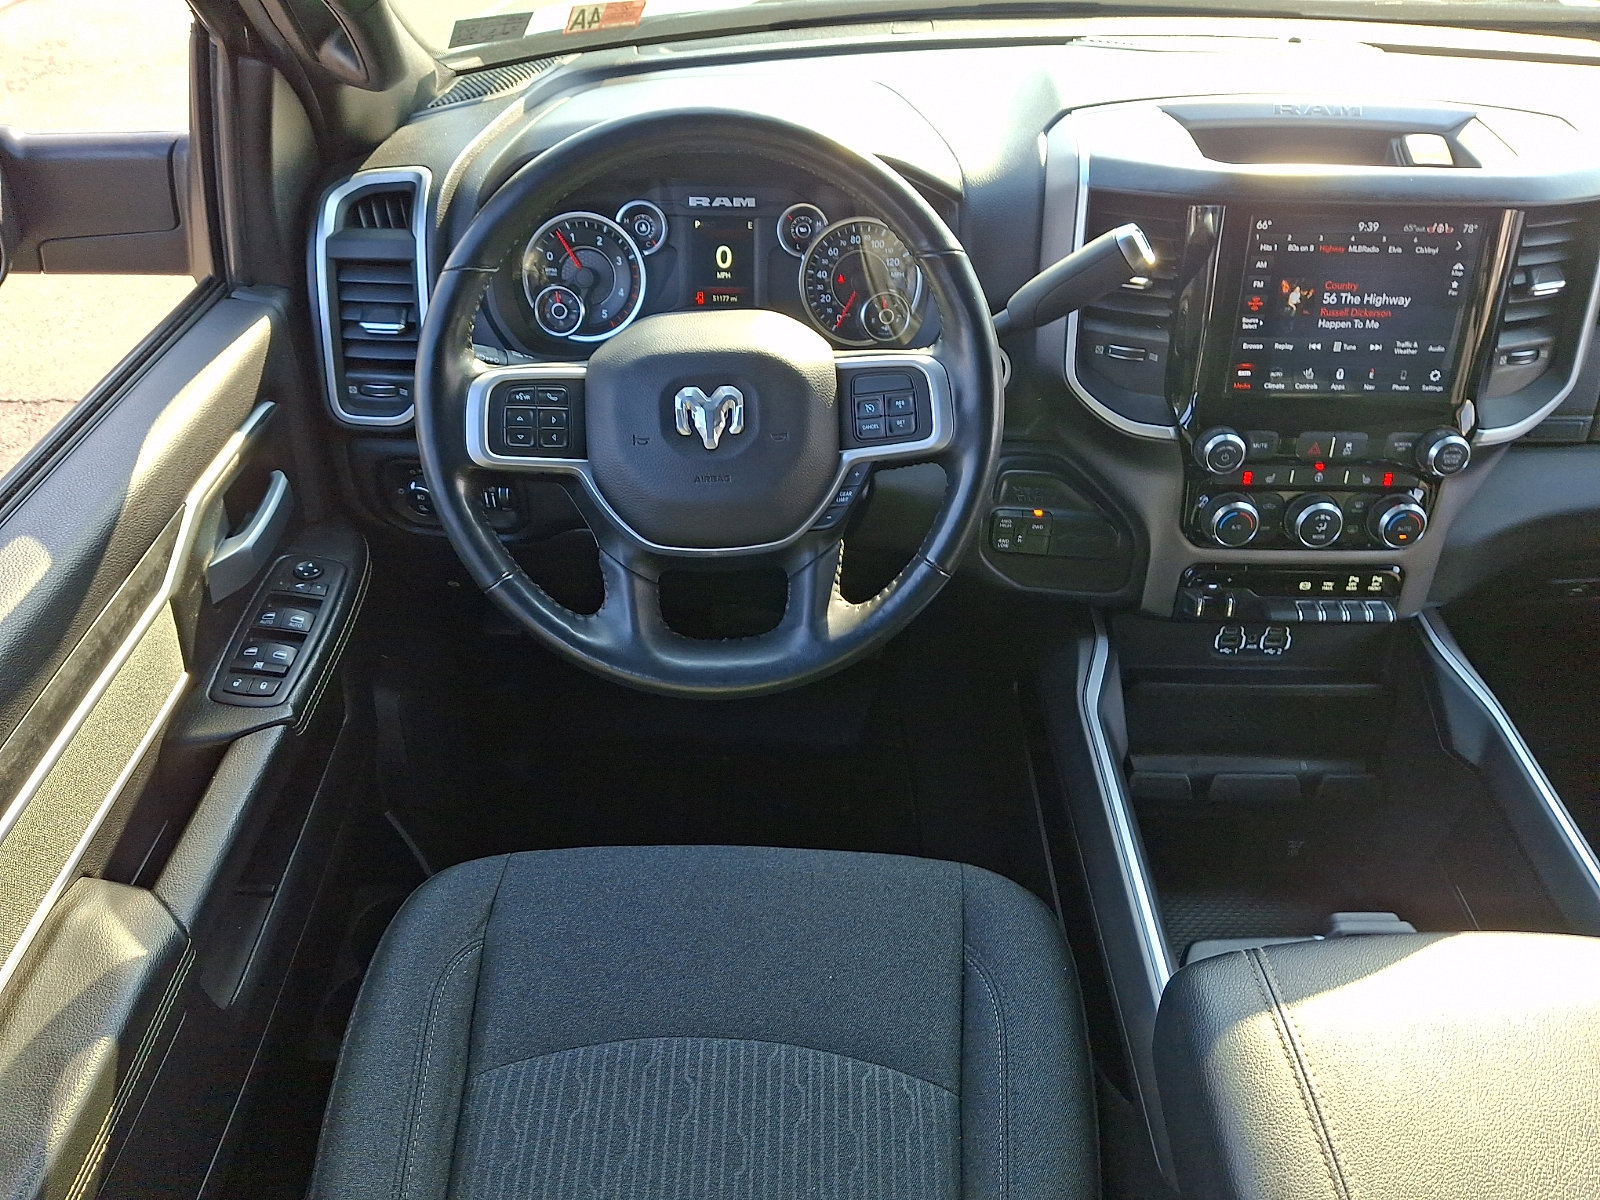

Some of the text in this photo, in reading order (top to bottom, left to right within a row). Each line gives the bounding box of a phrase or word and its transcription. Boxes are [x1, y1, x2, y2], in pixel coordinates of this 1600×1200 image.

[1272, 104, 1362, 117] RAM
[688, 196, 756, 207] RAM
[694, 220, 701, 228] P
[747, 221, 753, 230] E
[1358, 221, 1379, 232] 9:39
[570, 233, 575, 242] 1
[596, 236, 603, 246] 2
[850, 235, 861, 244] 80
[871, 240, 885, 248] 100
[547, 251, 554, 261] 0
[828, 247, 838, 256] 60
[616, 256, 622, 266] 3
[715, 245, 732, 269] 0
[887, 258, 900, 267] 120
[817, 271, 827, 279] 40
[1252, 280, 1264, 288] FM
[1324, 281, 1359, 292] Country
[618, 288, 624, 297] 4
[820, 294, 831, 303] 20
[1322, 292, 1412, 307] 56 The Highway
[602, 309, 608, 319] 5
[1320, 307, 1392, 318] Russell Dickerson
[1318, 319, 1380, 330] Happen To Me
[1274, 343, 1294, 351] Replay
[1343, 343, 1357, 351] Tune
[1428, 345, 1446, 353] Audio
[1264, 382, 1285, 390] Climate
[1330, 383, 1346, 391] Apps
[1421, 384, 1443, 392] Settings
